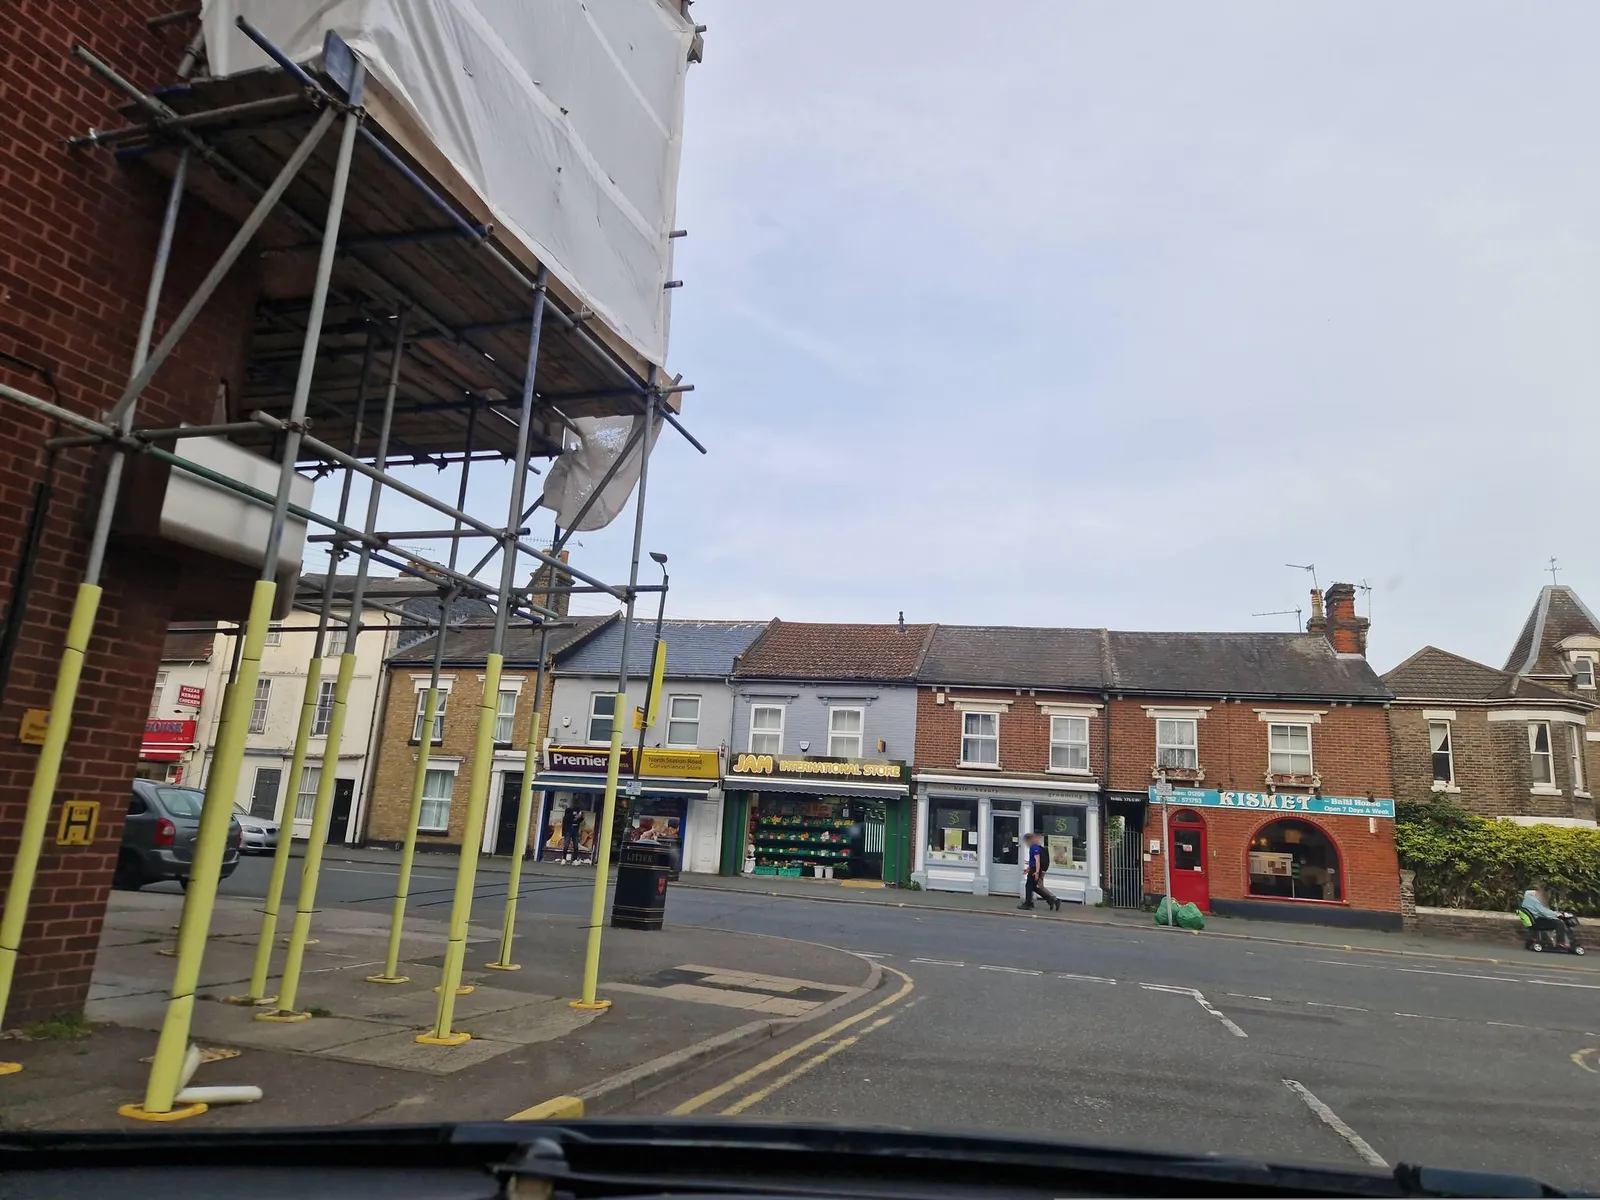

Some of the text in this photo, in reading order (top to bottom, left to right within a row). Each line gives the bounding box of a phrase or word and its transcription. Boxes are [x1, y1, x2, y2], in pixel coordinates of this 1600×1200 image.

[553, 753, 607, 767] Premier
[733, 754, 901, 778] JAM INTERNATIONAL STORE
[1219, 791, 1312, 811] KISMET
[1354, 799, 1381, 807] House
[627, 852, 653, 863] LITTER
